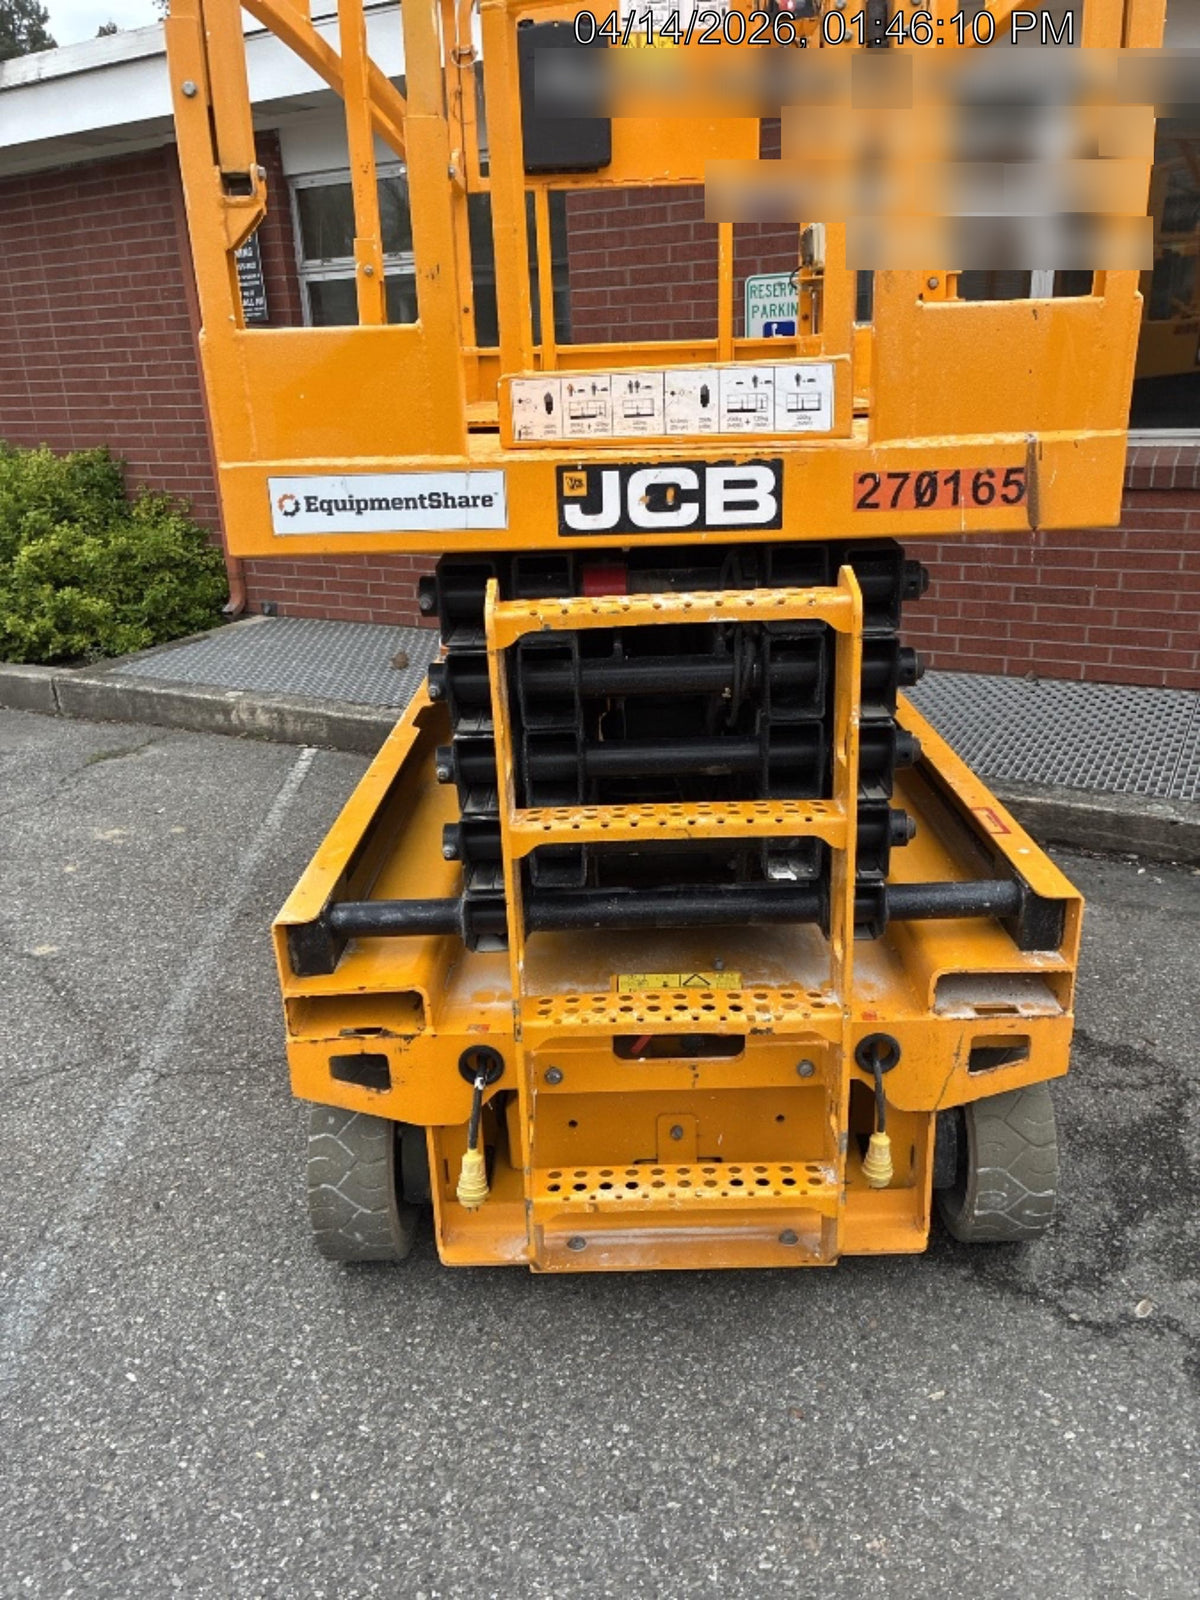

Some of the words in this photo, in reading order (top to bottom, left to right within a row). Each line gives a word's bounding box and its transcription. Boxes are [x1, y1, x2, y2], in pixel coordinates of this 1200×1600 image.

[304, 493, 494, 515] EquipmentShare
[563, 465, 778, 530] JCB
[856, 467, 1026, 509] 270165
